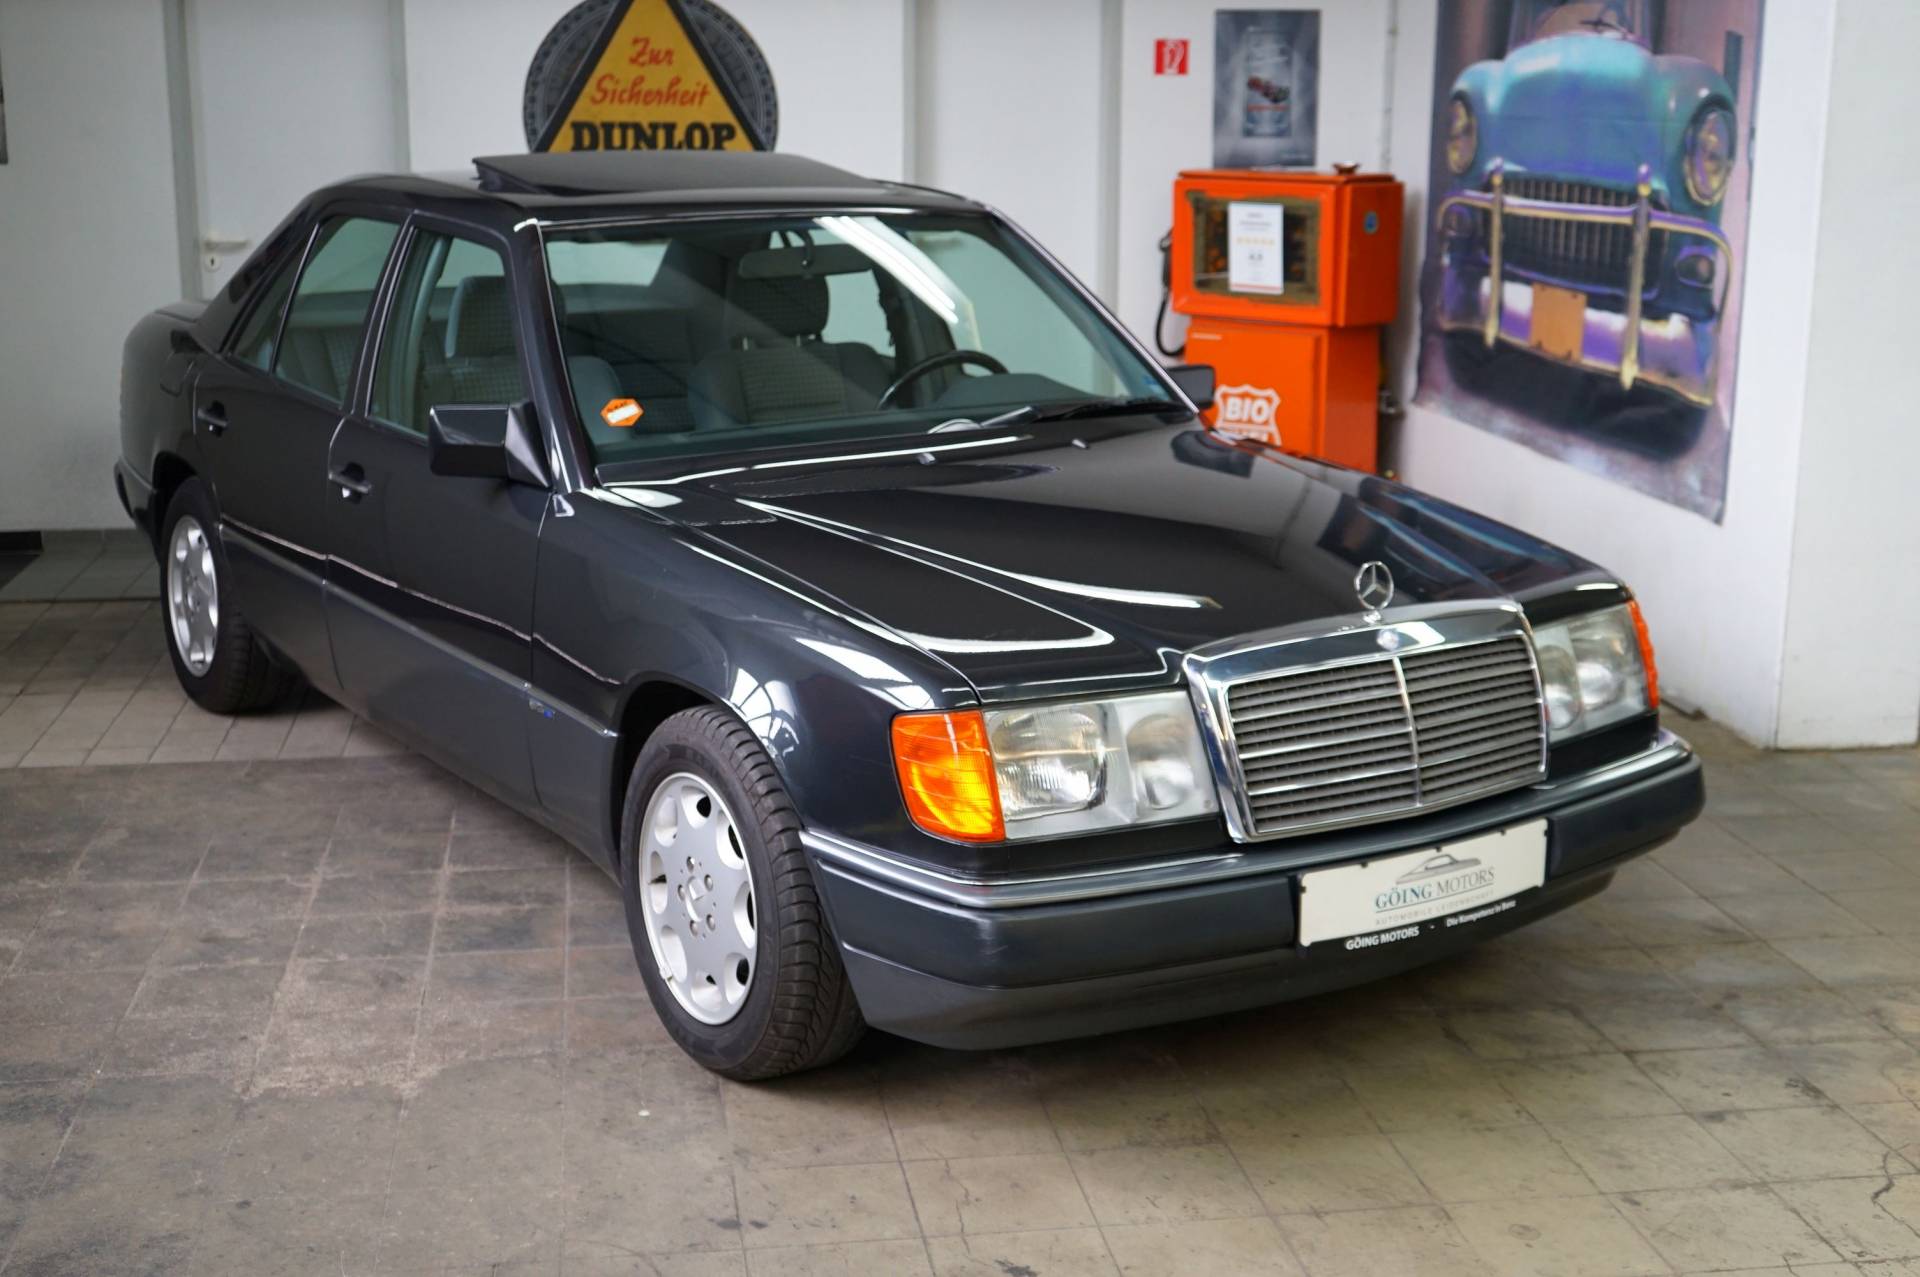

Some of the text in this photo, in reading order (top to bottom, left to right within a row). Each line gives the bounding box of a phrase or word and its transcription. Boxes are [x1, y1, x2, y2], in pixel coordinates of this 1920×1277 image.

[628, 36, 675, 67] Zur
[590, 73, 710, 107] Sicherheit
[570, 121, 737, 150] DUNLOP
[1226, 396, 1271, 424] BIO
[1375, 867, 1495, 910] GÖING MOTORS
[1345, 934, 1379, 950] GÖING
[1380, 926, 1420, 944] MOTORS
